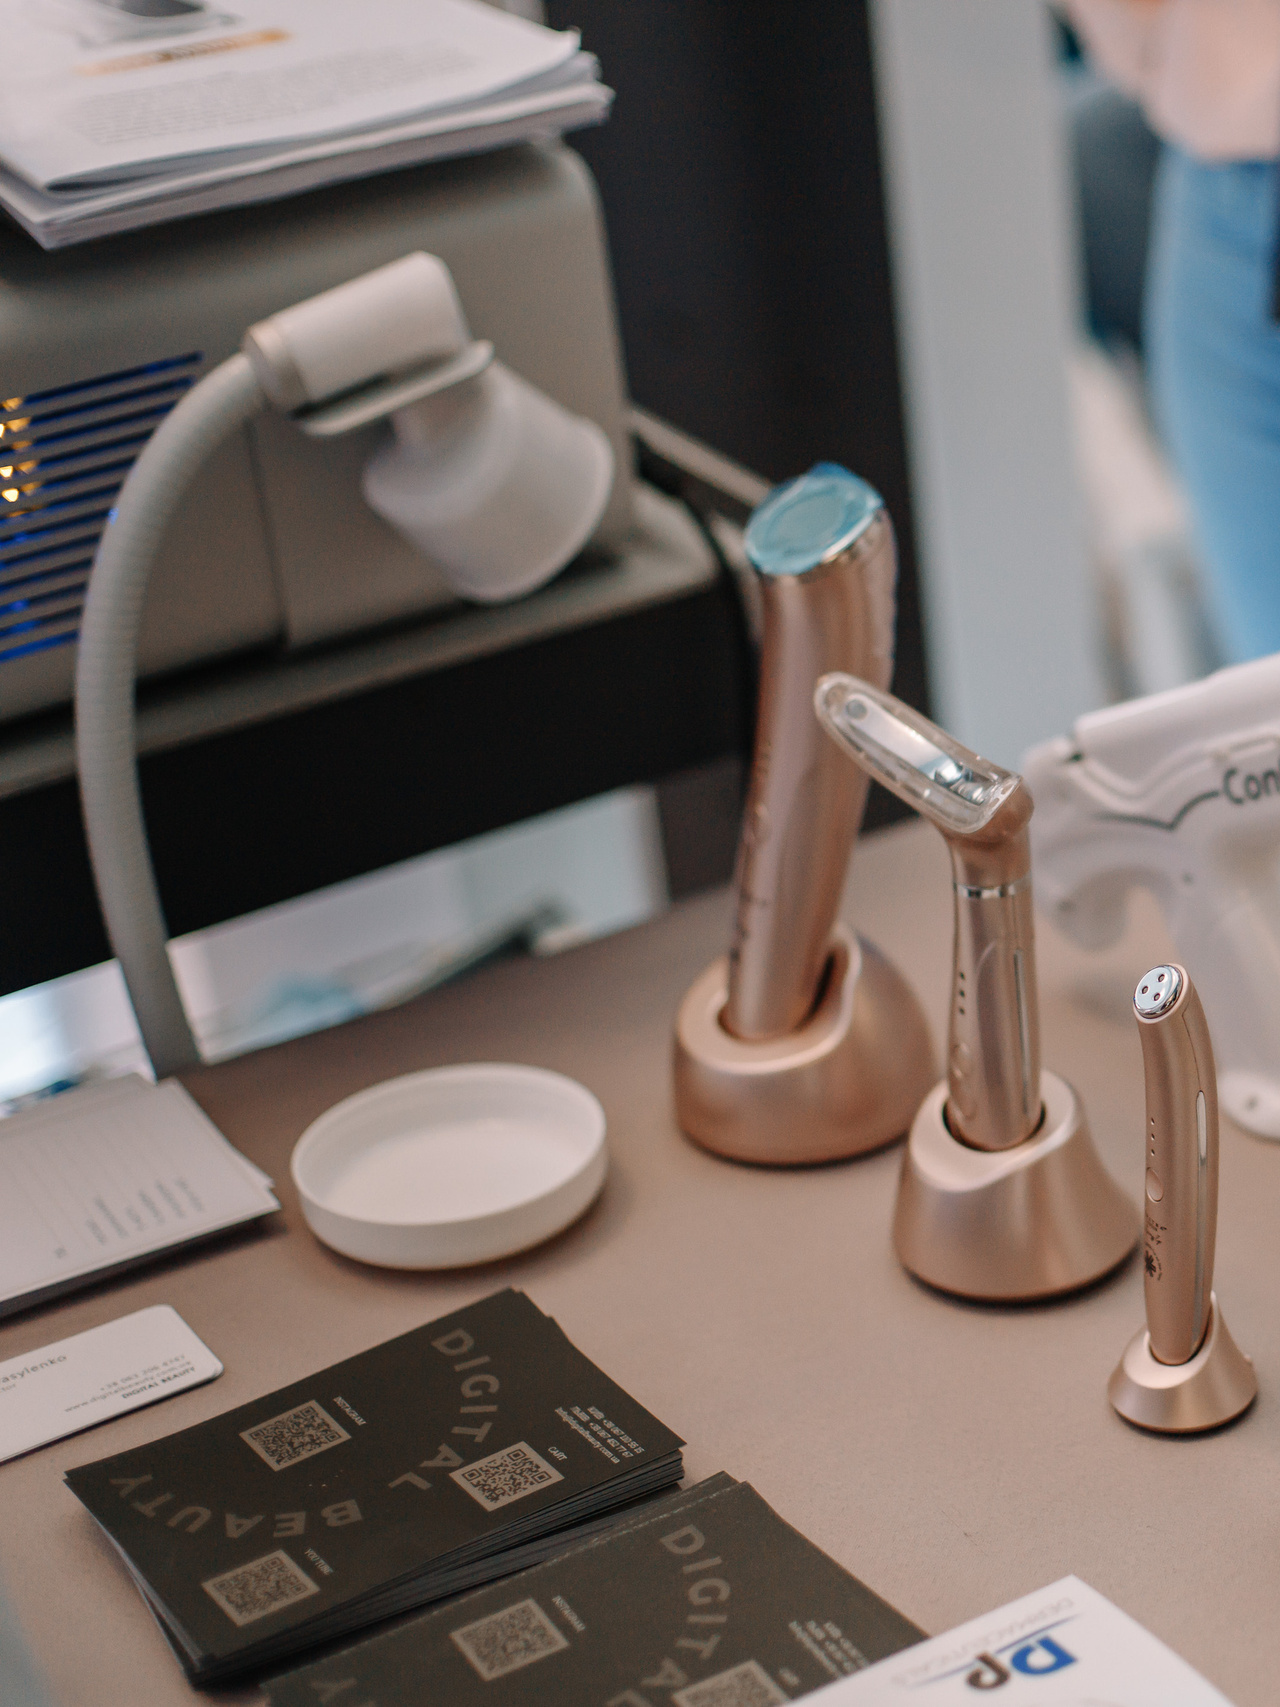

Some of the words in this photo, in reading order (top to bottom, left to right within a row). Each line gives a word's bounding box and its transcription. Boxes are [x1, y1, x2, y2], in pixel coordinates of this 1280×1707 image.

[333, 1396, 367, 1427] INSTAGRAM
[388, 1328, 500, 1491] DIGITAL
[109, 1472, 364, 1539] BEAUTY
